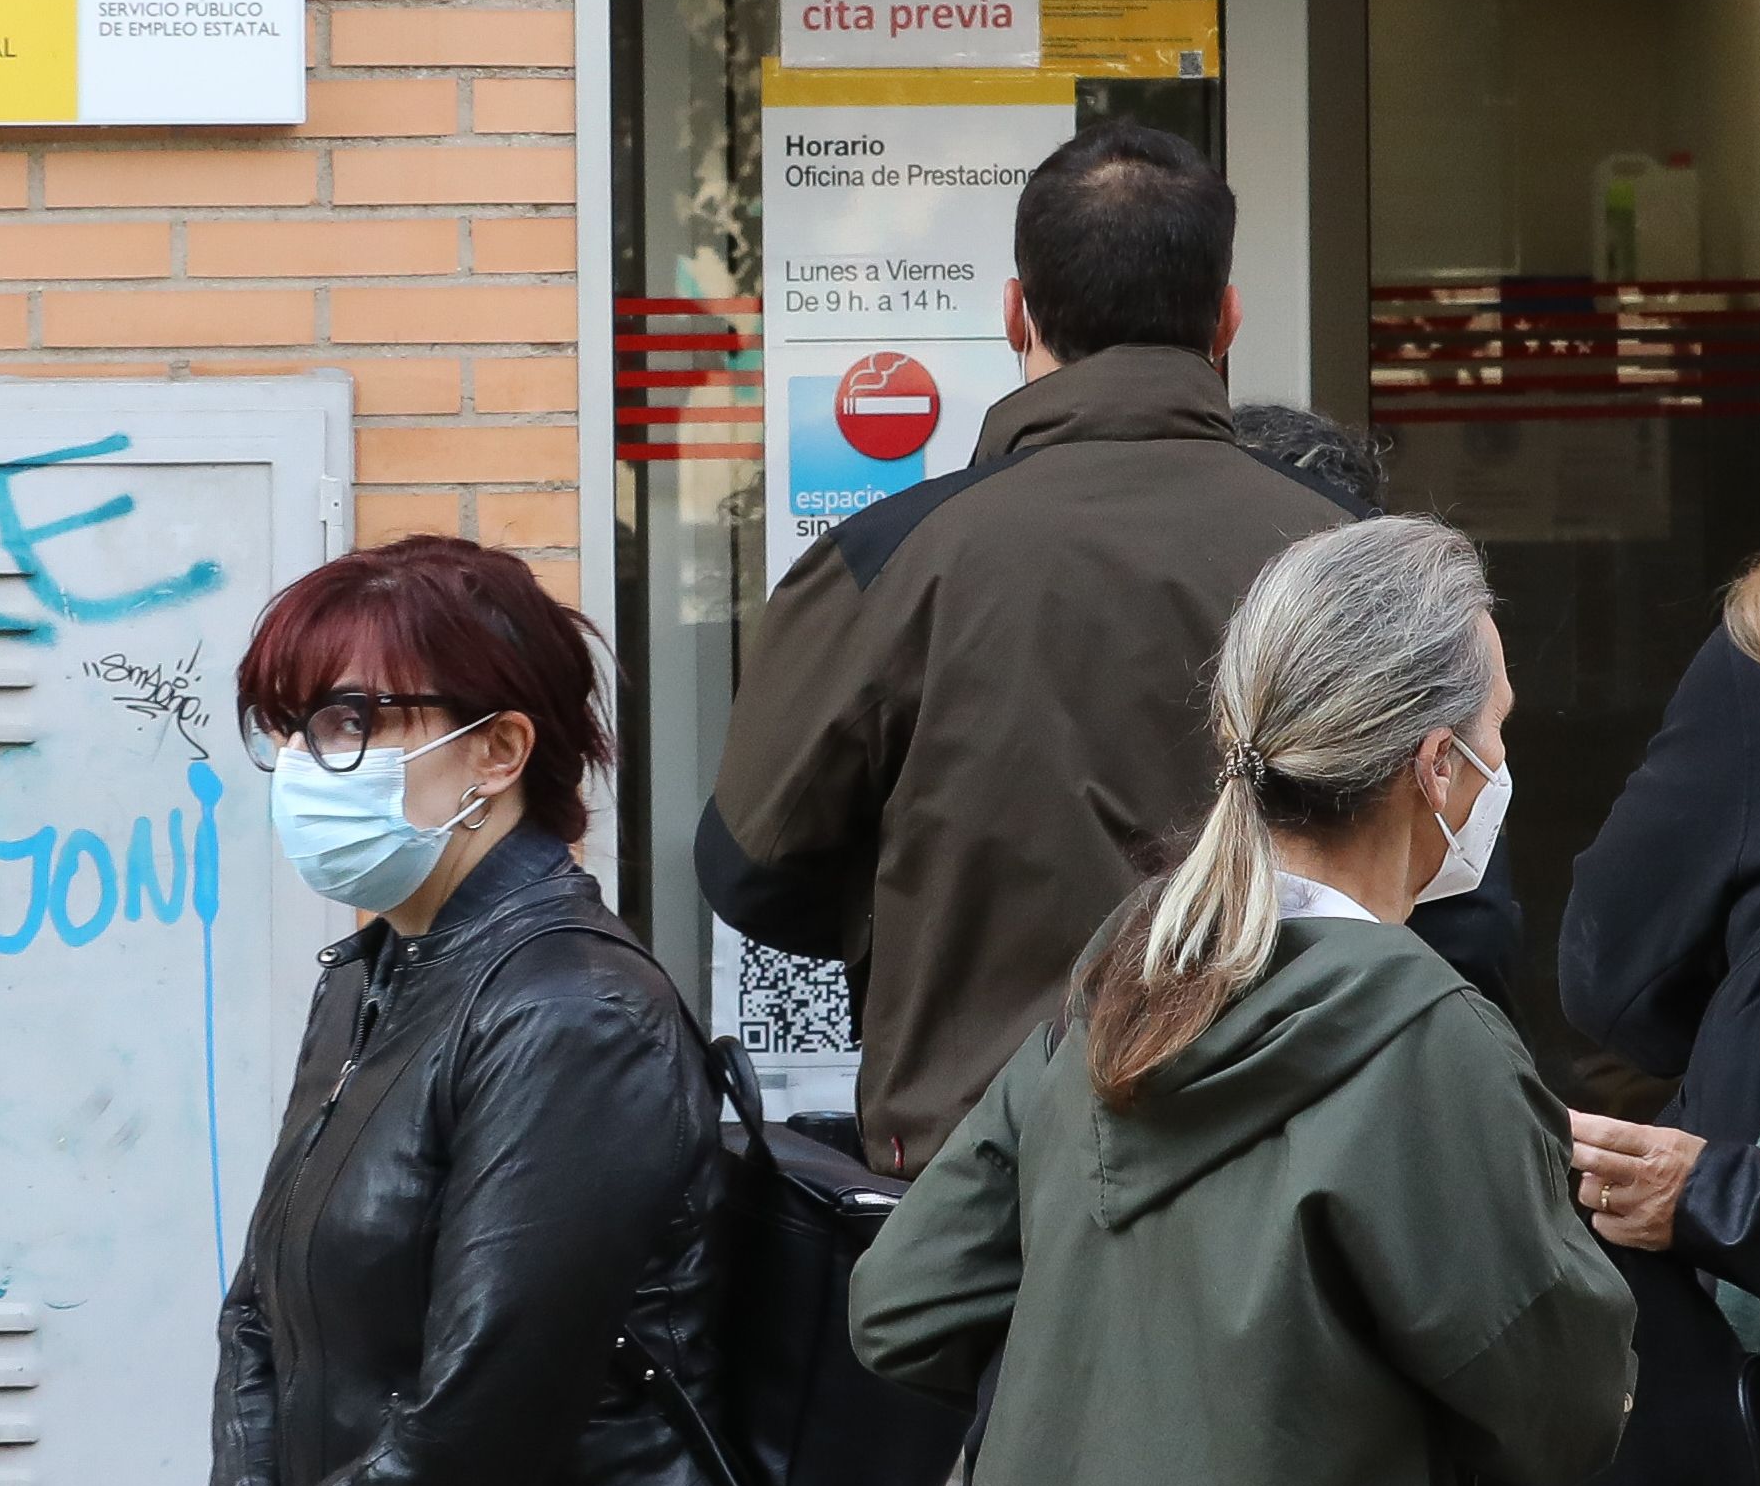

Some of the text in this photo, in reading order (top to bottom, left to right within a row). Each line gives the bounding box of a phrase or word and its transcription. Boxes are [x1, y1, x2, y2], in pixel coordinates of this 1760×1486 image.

[99, 0, 263, 17] SERVICIO PÚBLICO
[99, 21, 280, 36] DE EMPLEO ESTATAL
[786, 135, 884, 156] Horario
[786, 164, 1037, 187] Oficina de Prestacion
[786, 259, 974, 282] Lunes a Viernes
[786, 290, 957, 312] De 9 h. a 14 h.
[796, 484, 888, 512] espacio
[796, 514, 831, 537] sin
